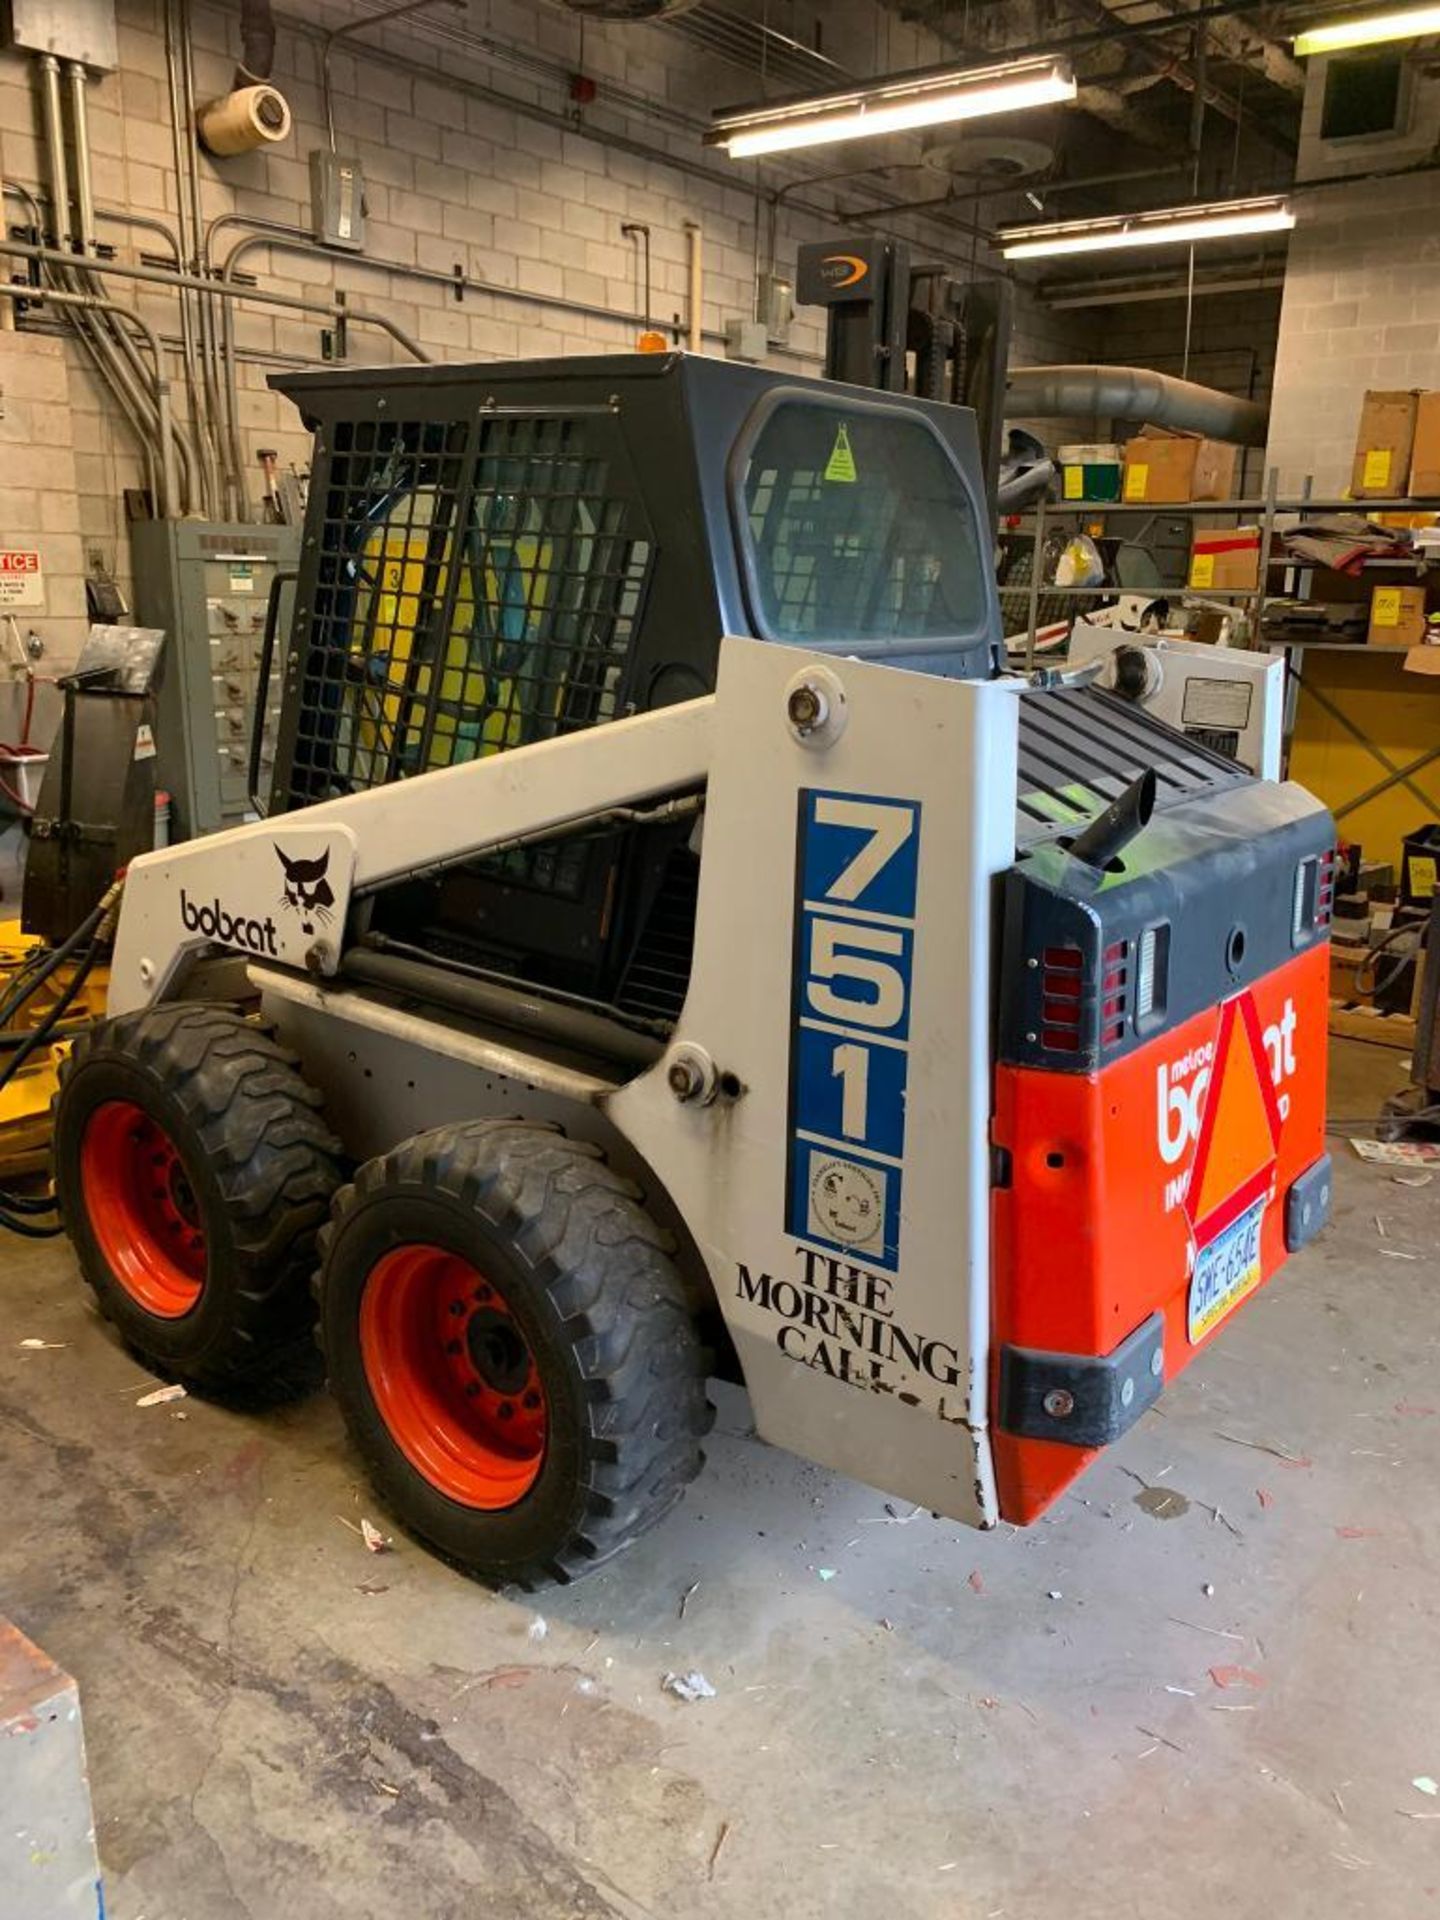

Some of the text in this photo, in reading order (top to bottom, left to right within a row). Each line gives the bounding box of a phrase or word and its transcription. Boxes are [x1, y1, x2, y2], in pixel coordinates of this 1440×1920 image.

[181, 889, 277, 956] bobcat
[807, 796, 915, 1142] 751
[735, 1262, 962, 1387] MORNING
[796, 1247, 894, 1318] THE
